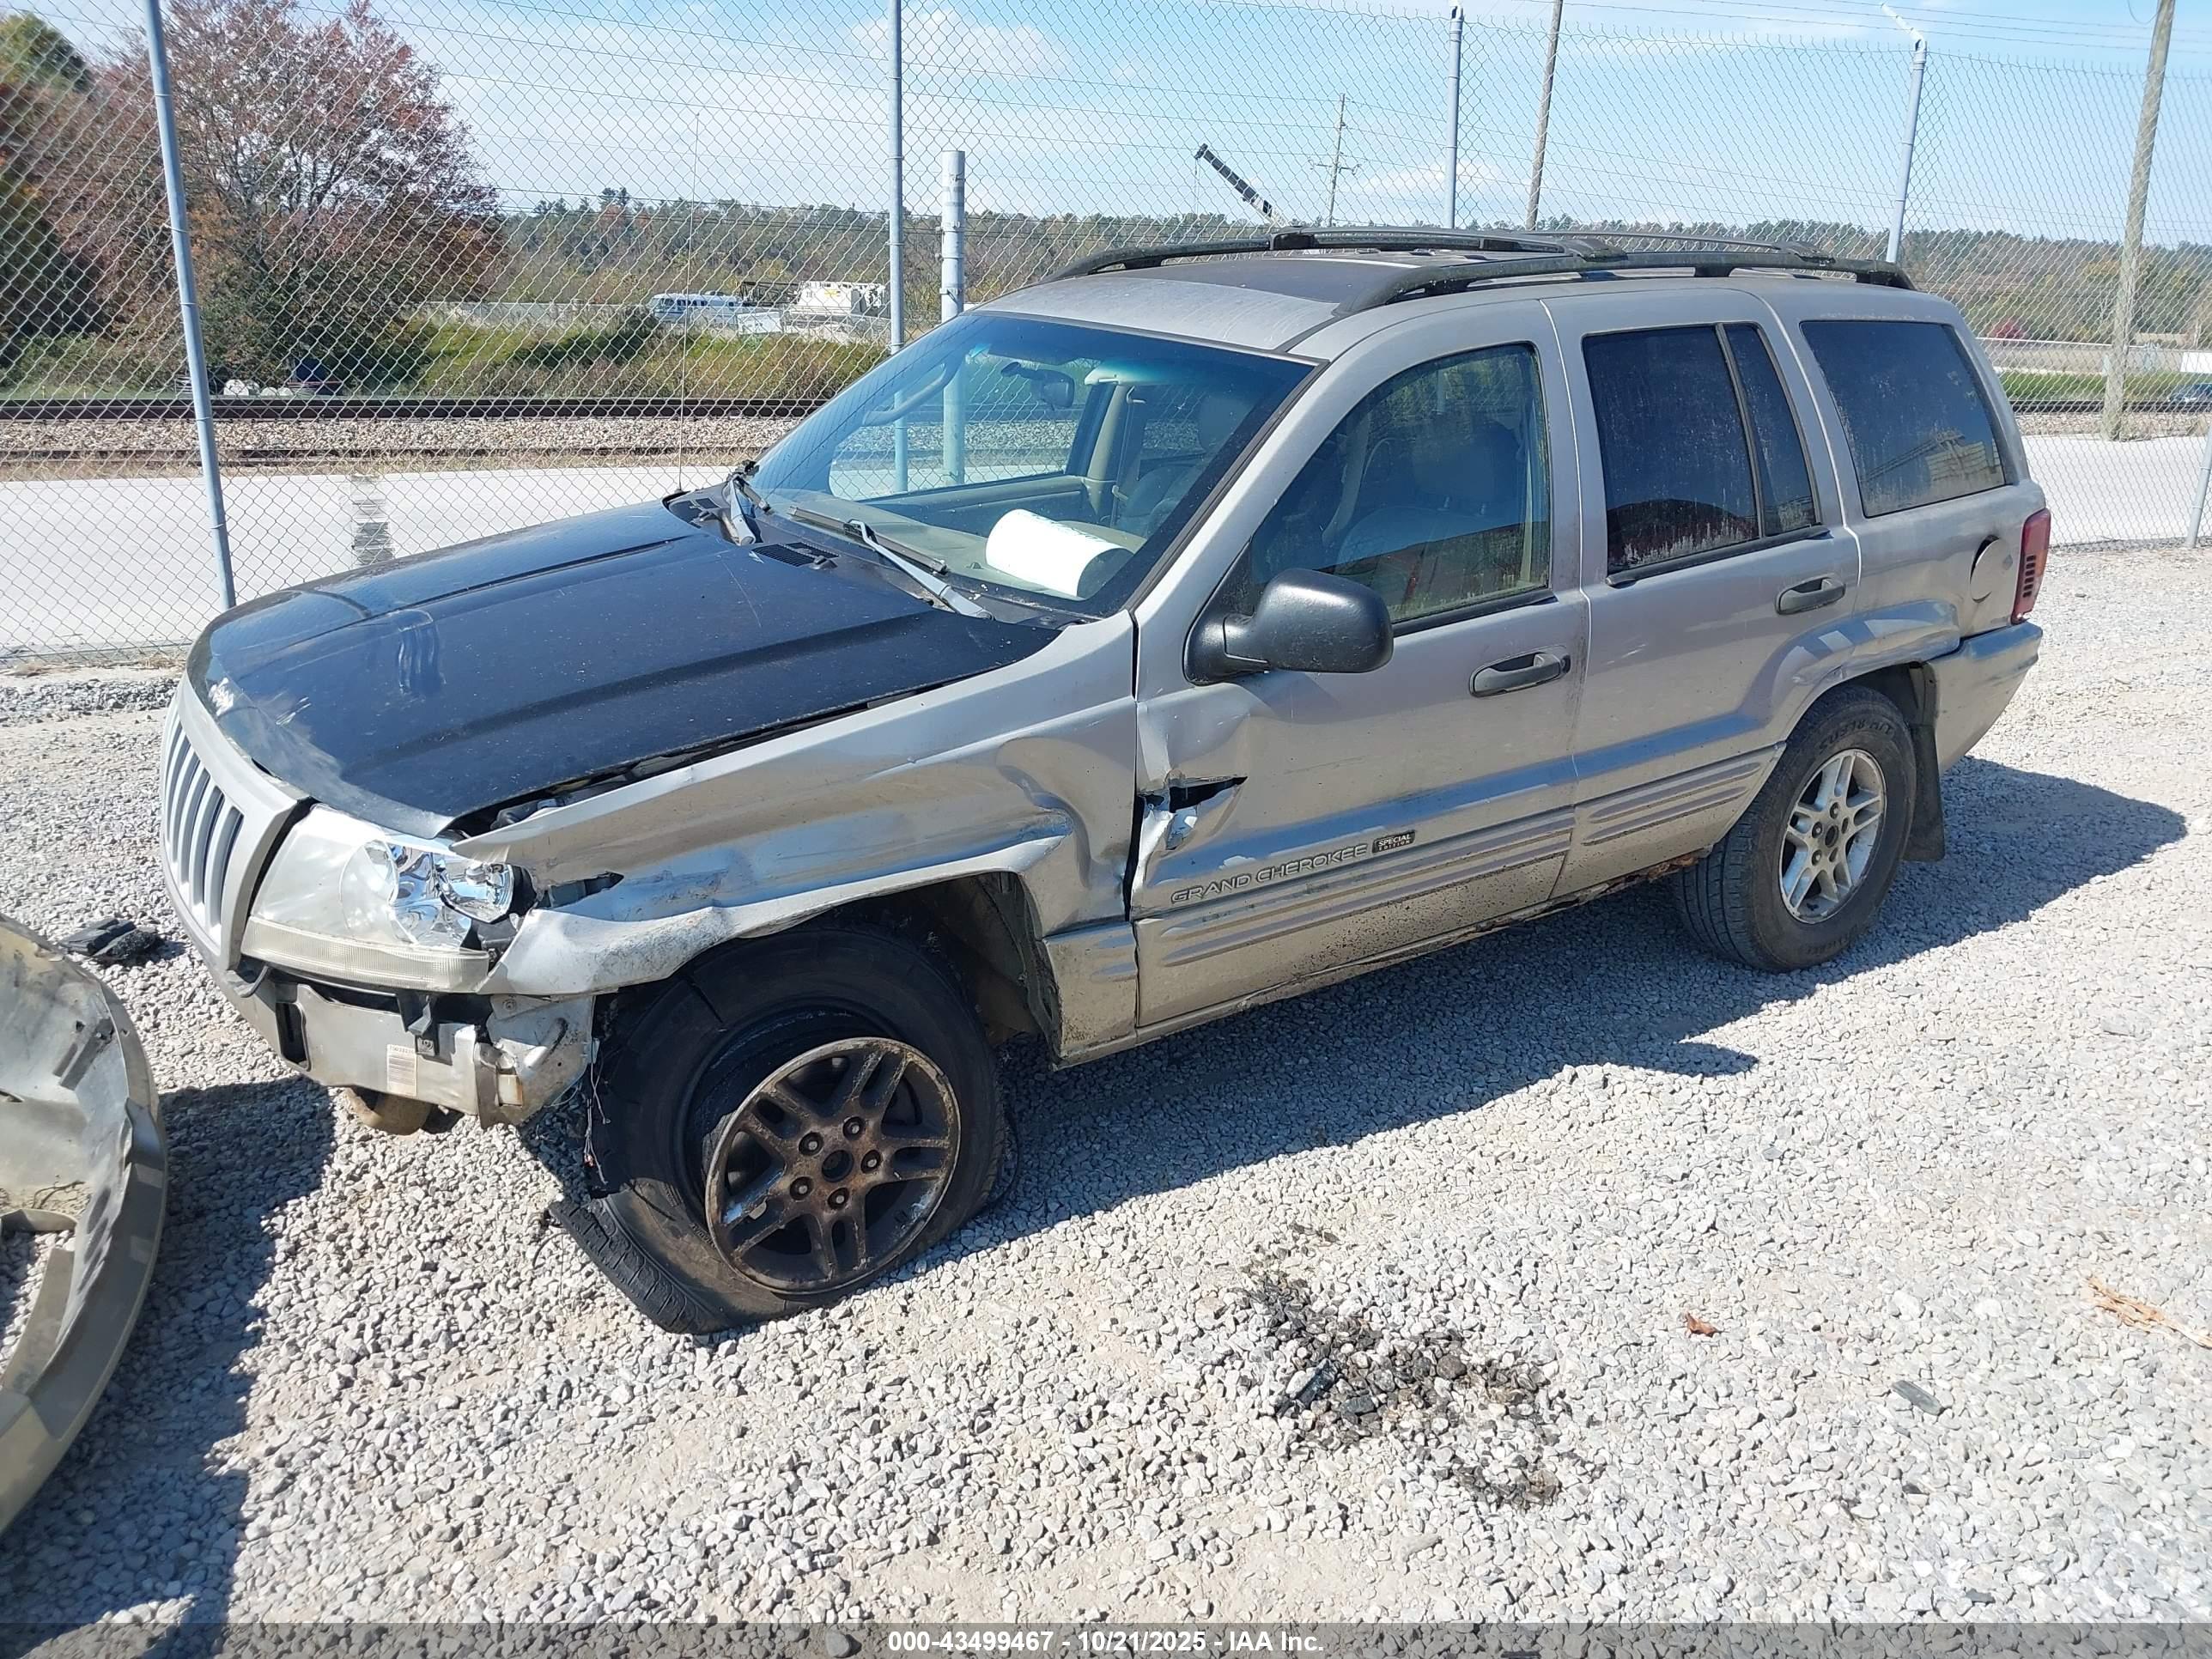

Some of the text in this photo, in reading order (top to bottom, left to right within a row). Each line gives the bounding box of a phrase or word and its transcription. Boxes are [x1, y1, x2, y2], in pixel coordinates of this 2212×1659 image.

[1377, 834, 1411, 847] SPECIAL
[1171, 844, 1368, 903] GRAND CHEROKEE
